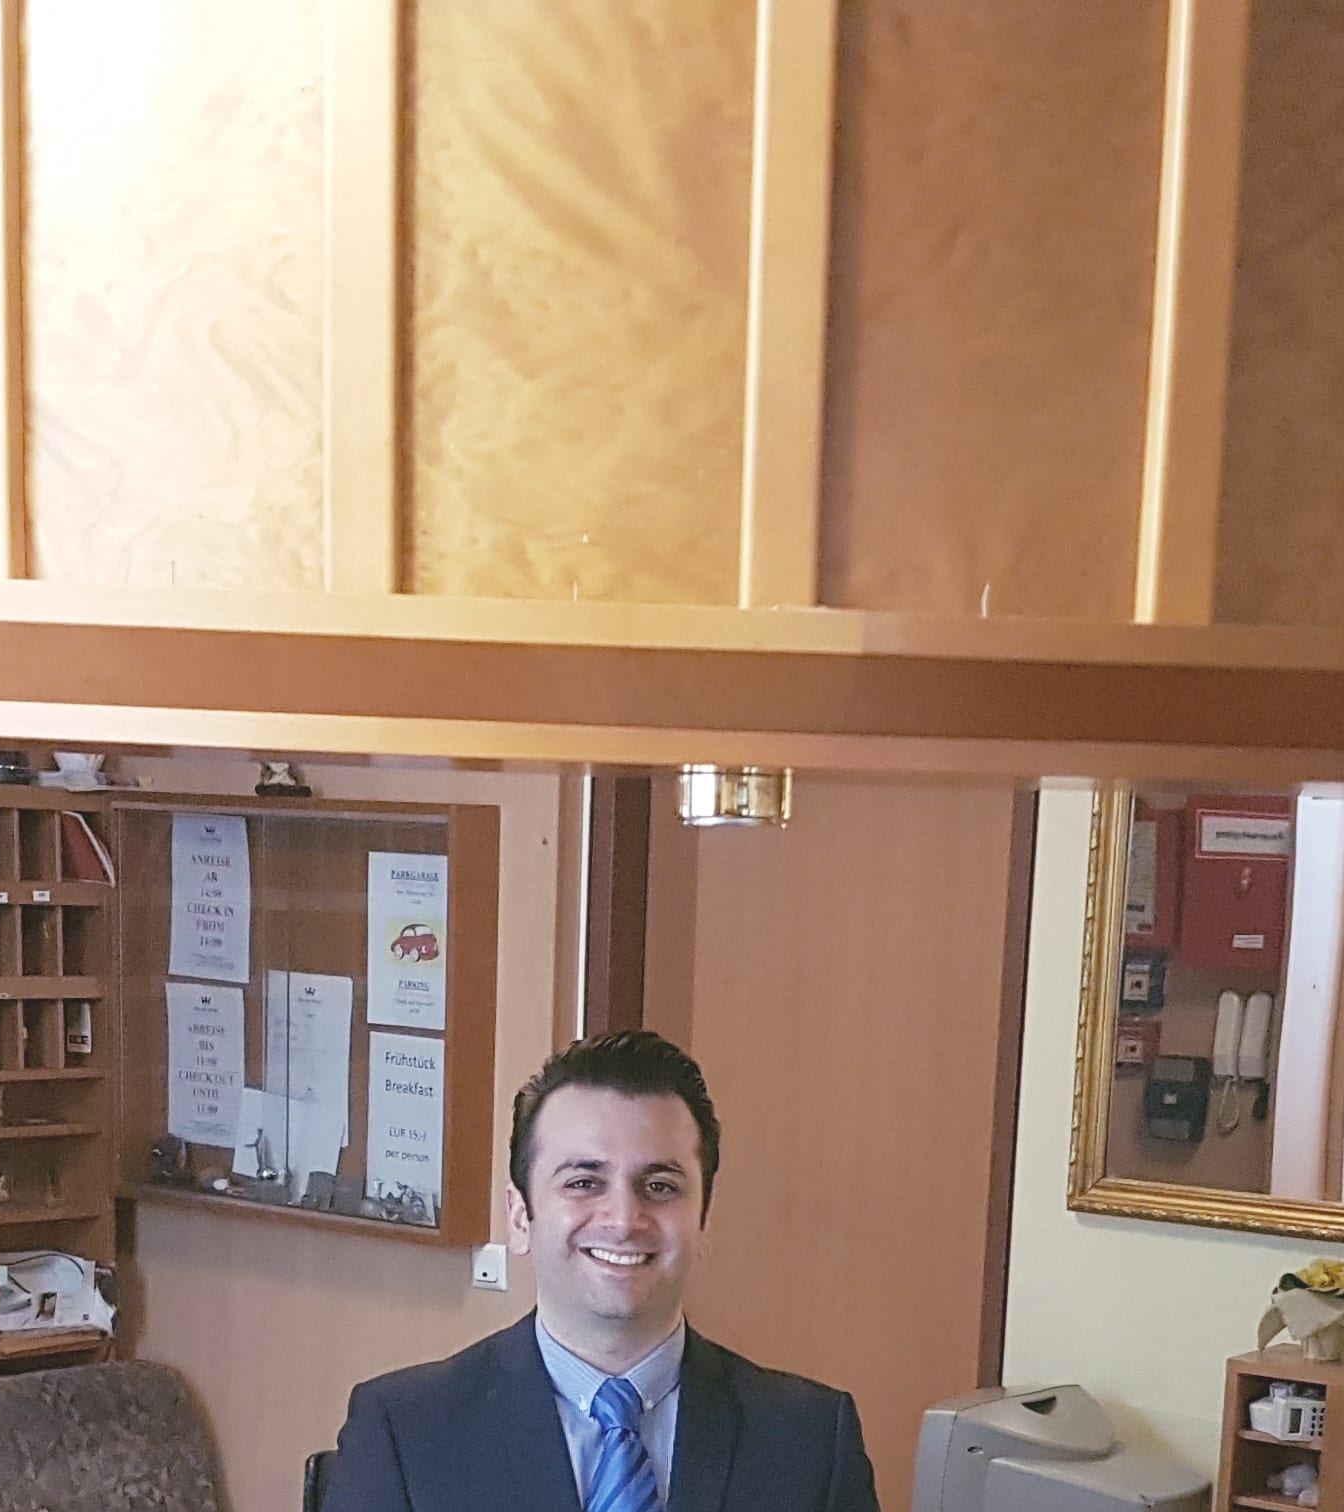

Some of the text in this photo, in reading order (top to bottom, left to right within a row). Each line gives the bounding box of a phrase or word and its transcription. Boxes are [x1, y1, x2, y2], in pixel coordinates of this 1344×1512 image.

[186, 902, 222, 916] CHECK
[385, 1079, 434, 1098] Breakfast
[402, 1152, 430, 1163] person
